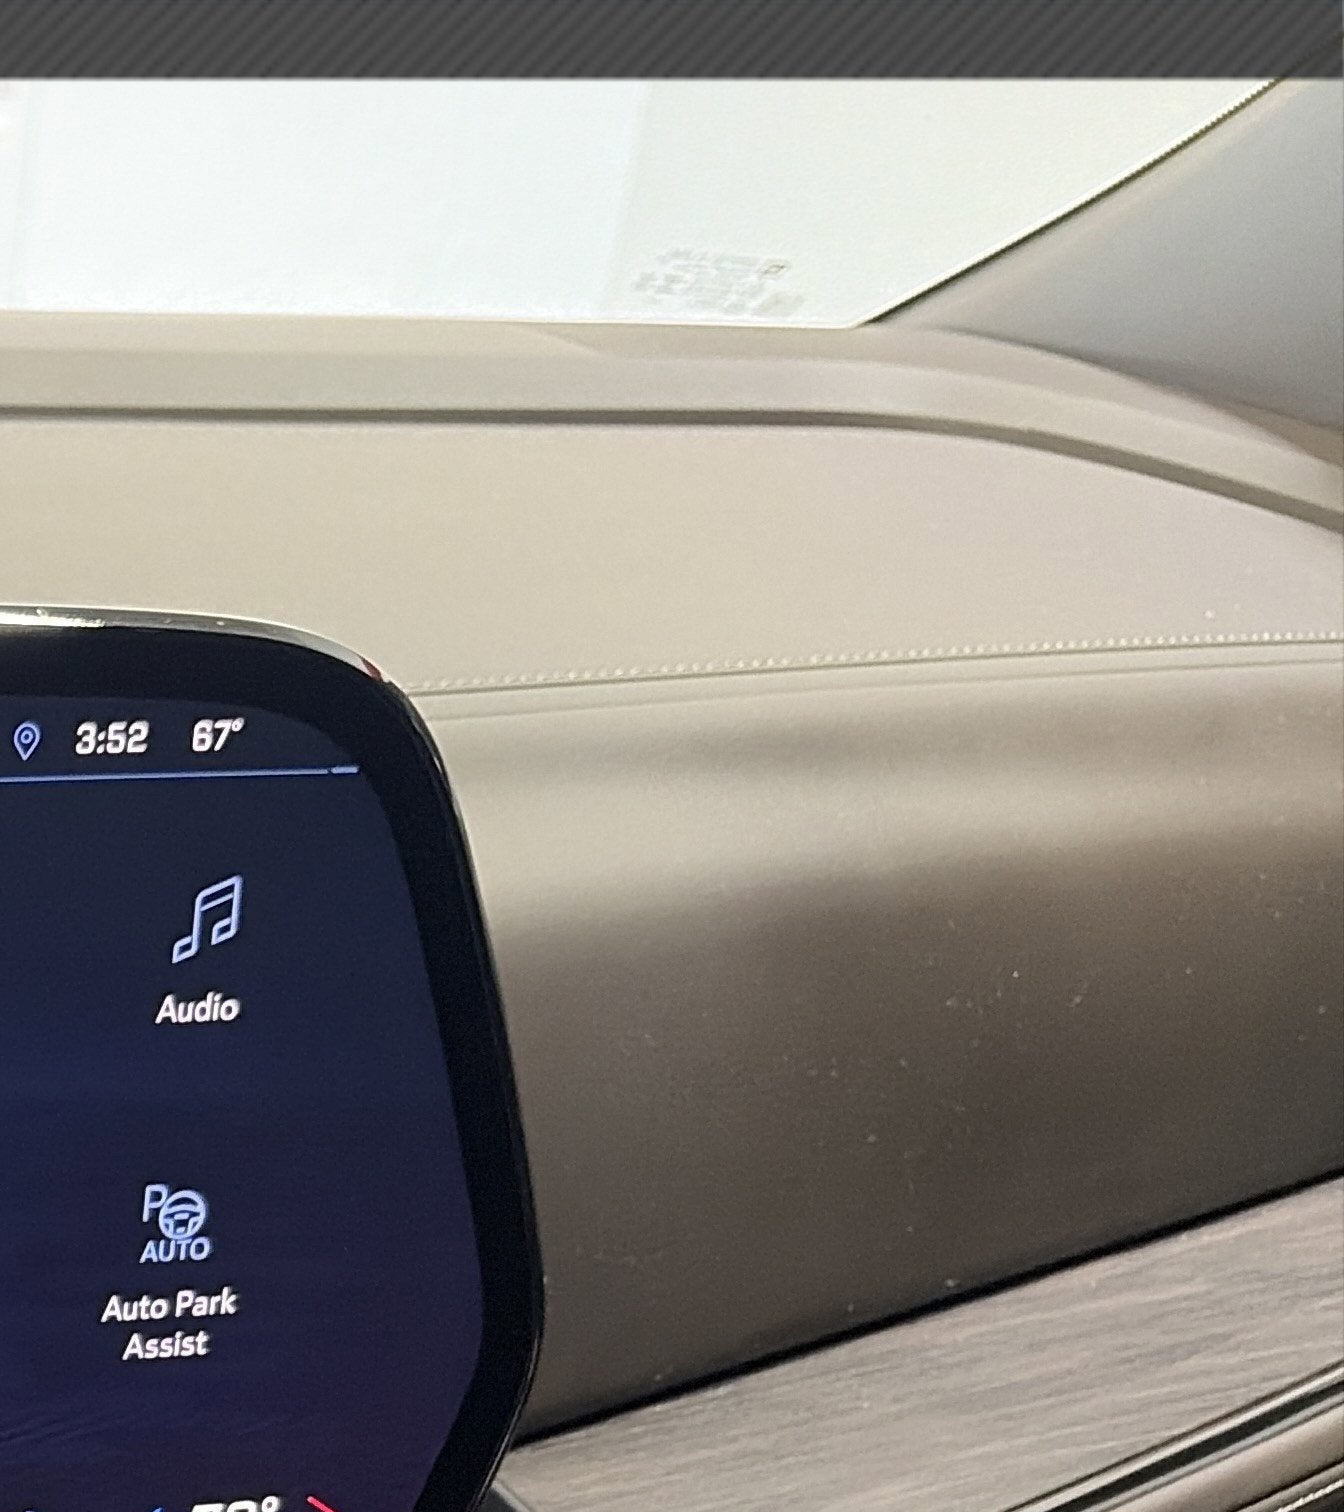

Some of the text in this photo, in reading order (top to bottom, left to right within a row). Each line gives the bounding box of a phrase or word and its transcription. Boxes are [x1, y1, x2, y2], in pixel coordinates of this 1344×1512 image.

[76, 721, 149, 754] 3:52
[155, 992, 240, 1023] Audio
[140, 1236, 211, 1263] AUTO
[101, 1287, 237, 1322] Auto Park
[123, 1331, 209, 1360] Assist
